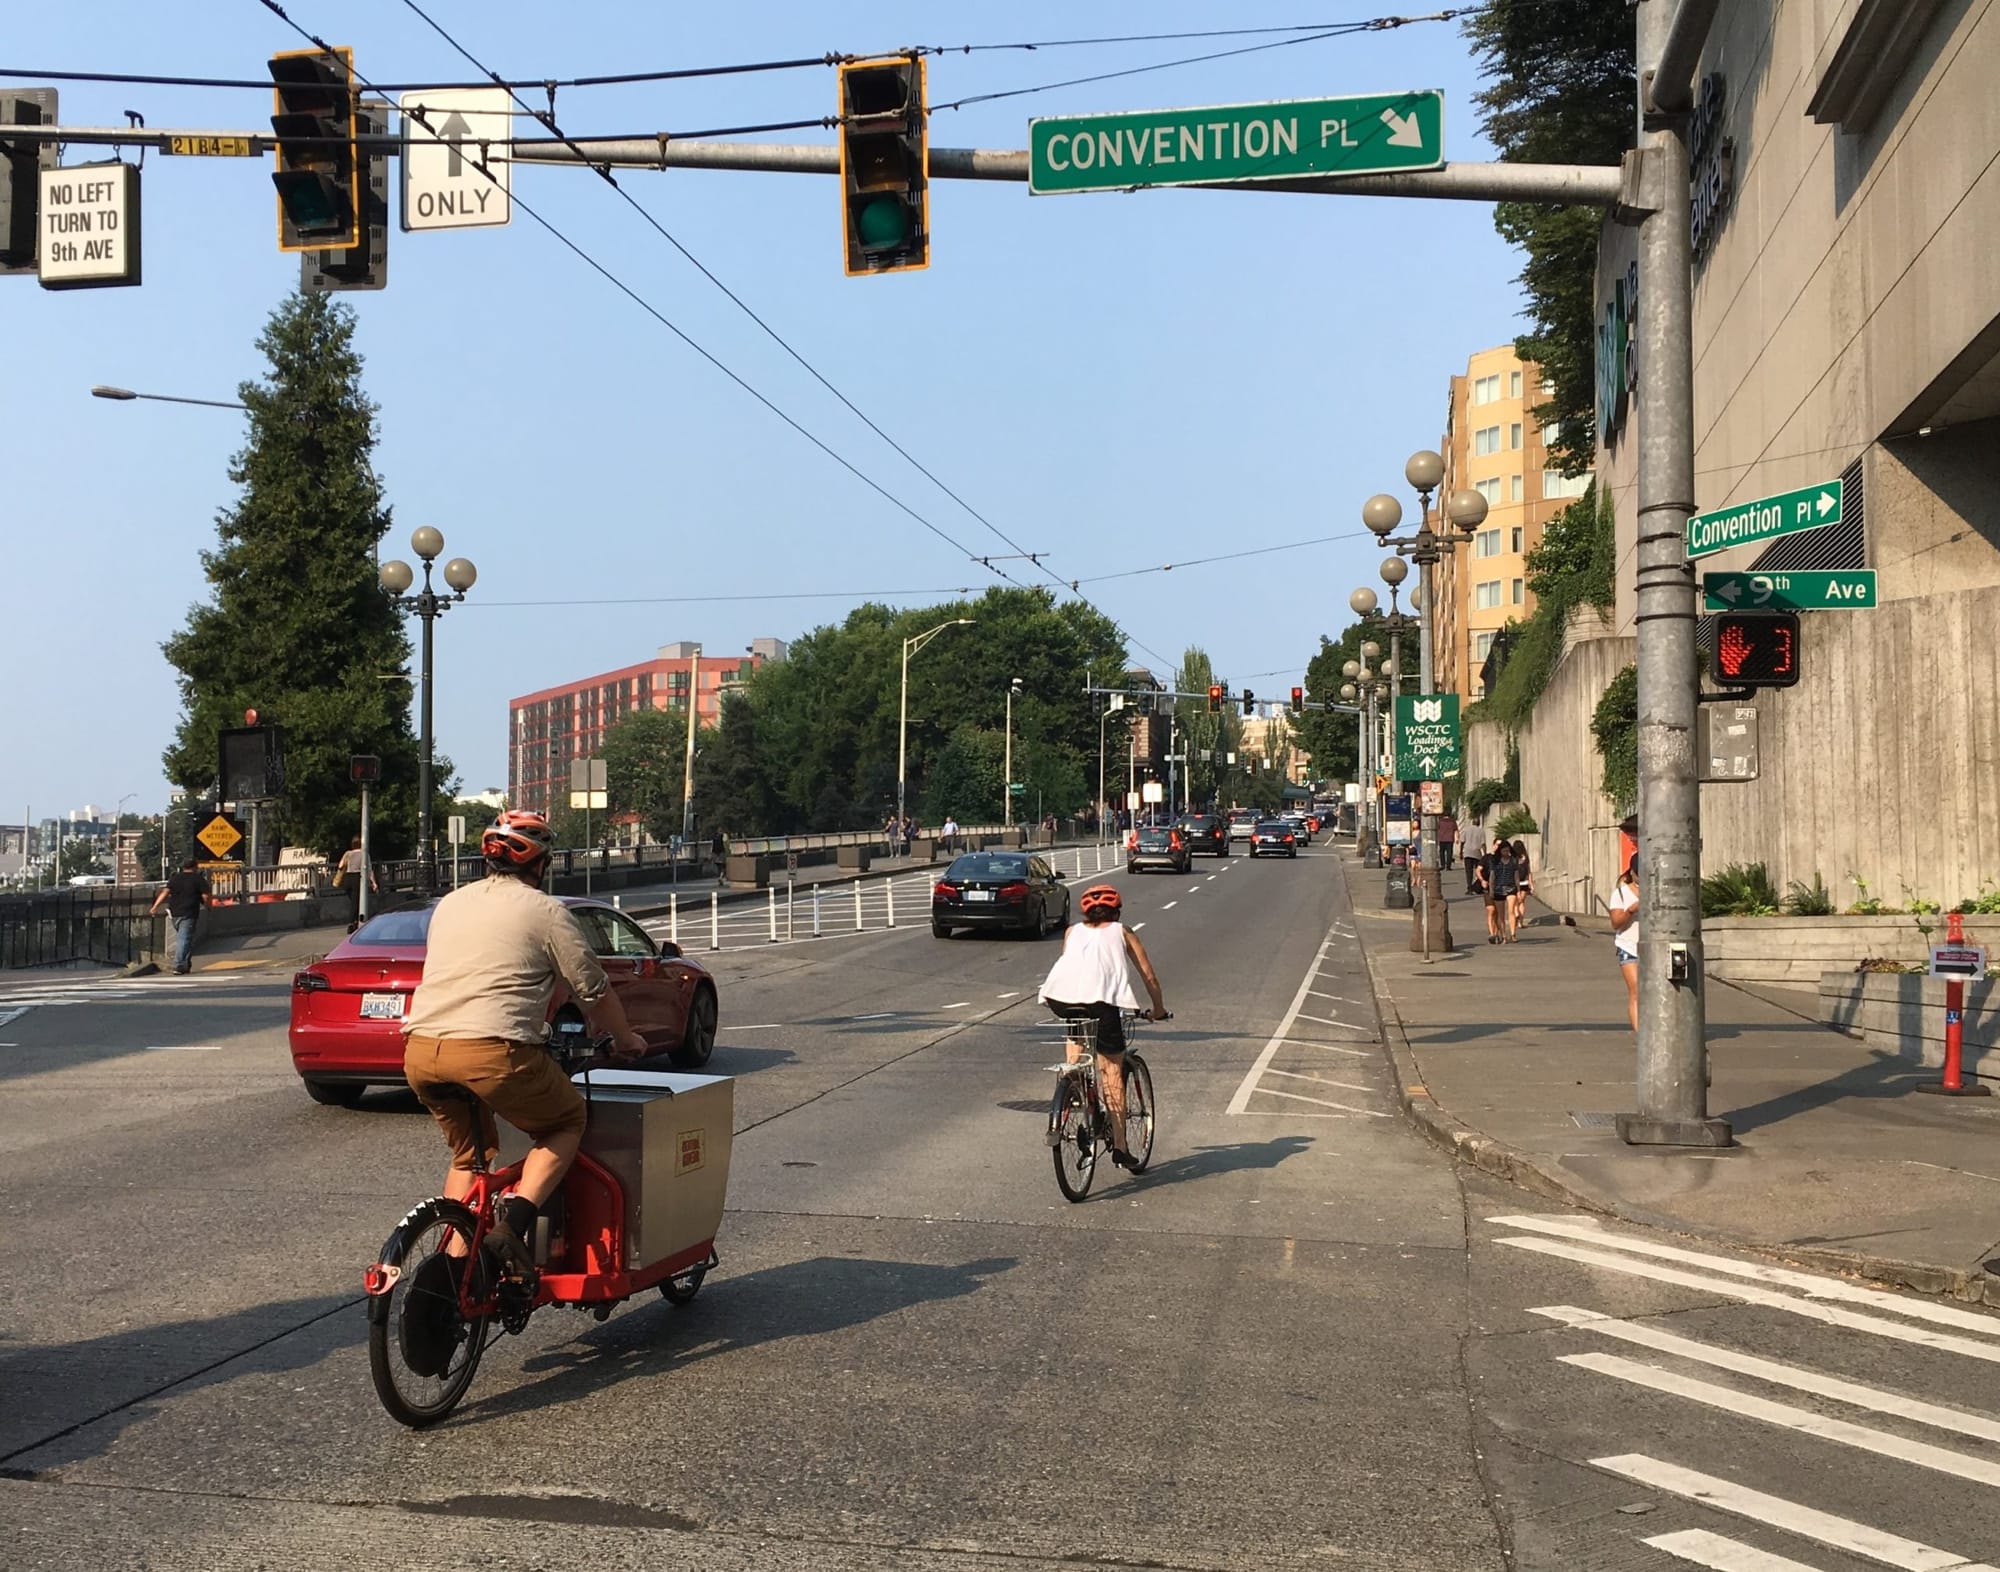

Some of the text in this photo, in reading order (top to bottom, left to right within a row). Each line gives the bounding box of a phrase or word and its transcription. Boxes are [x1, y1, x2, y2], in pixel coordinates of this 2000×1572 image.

[1046, 117, 1358, 172] CONVENTION PL
[49, 181, 115, 206] NO LEFT
[417, 187, 494, 218] ONLY
[47, 210, 119, 234] TURN TO
[51, 239, 114, 262] 9th AVE
[1691, 503, 1782, 549] Convention
[1749, 576, 1867, 604] 9th Ave
[1404, 724, 1451, 736] WSCTC
[1408, 736, 1447, 747] Loading
[1413, 745, 1441, 755] Dock
